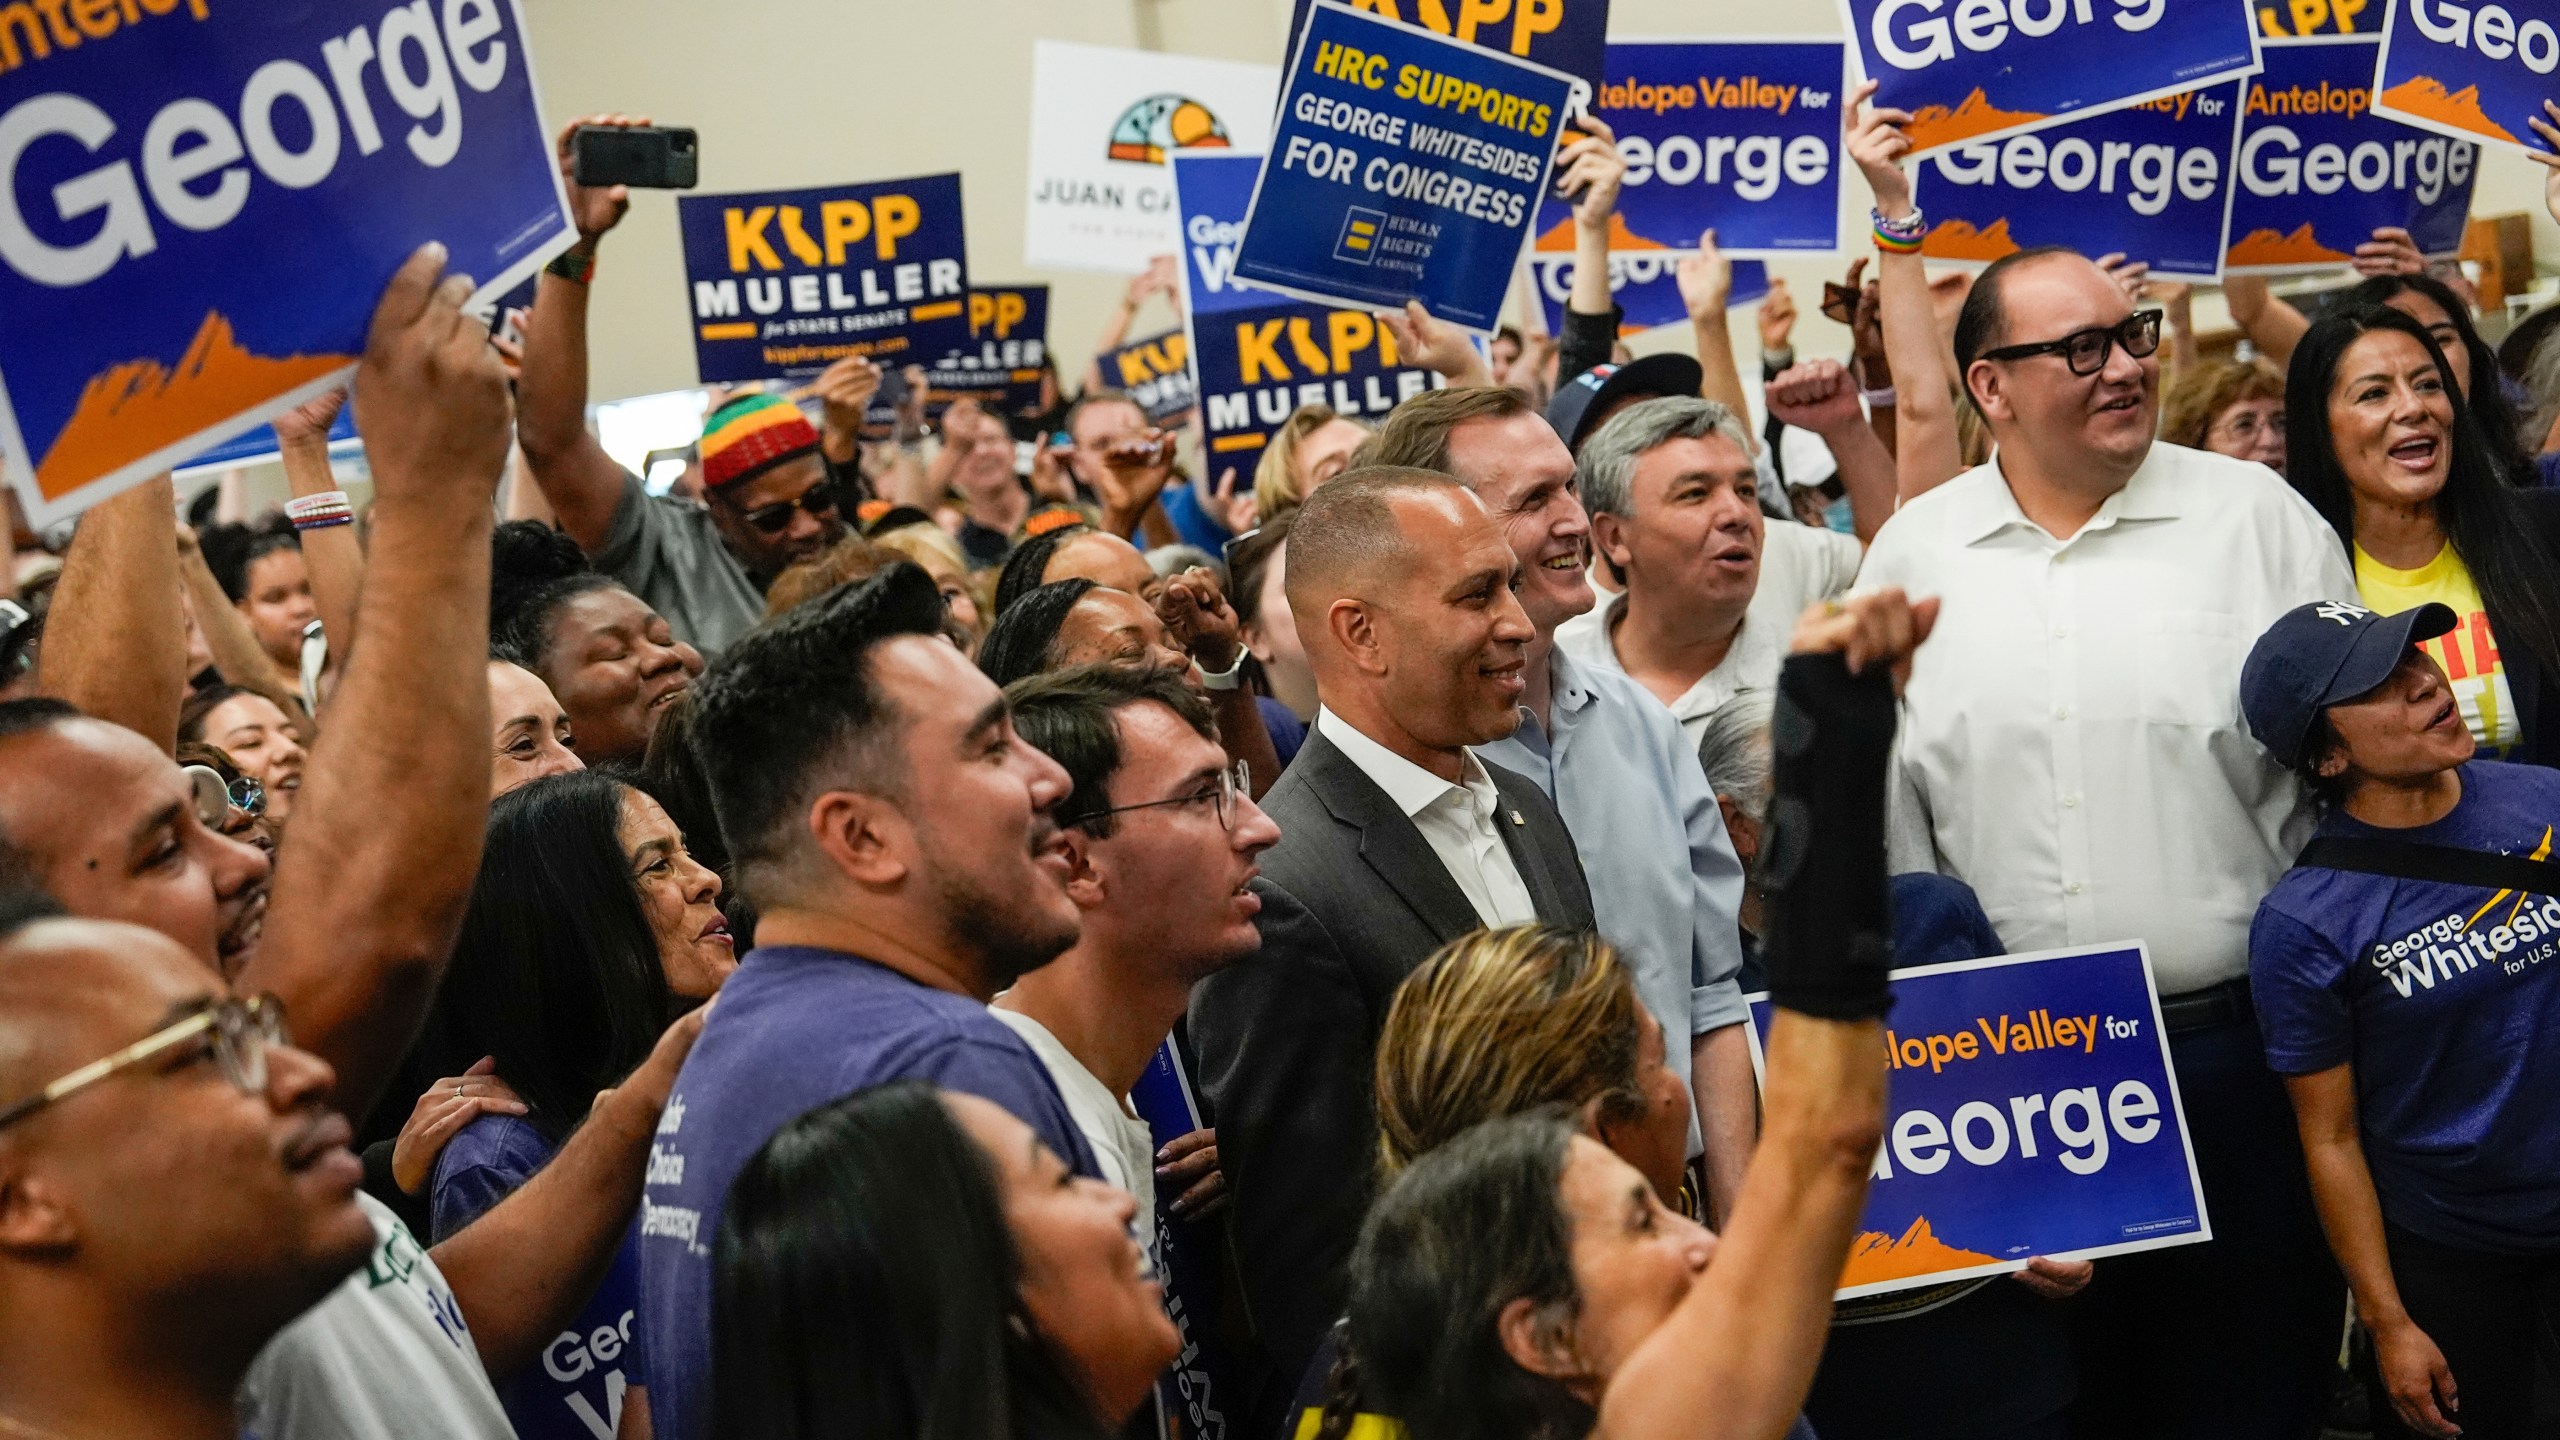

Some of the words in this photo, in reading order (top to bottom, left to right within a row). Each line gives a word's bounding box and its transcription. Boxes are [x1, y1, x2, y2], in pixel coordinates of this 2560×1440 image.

[1313, 40, 1389, 90] HRC
[1393, 64, 1551, 137] SUPPORTS
[1698, 75, 1797, 116] Valley
[1799, 86, 1831, 109] for
[2196, 93, 2225, 117] for
[0, 0, 507, 287] George
[1294, 92, 1406, 146] GEORGE
[1408, 122, 1541, 183] WHITESIDES
[1035, 178, 1126, 208] JUAN
[1282, 135, 1358, 185] FOR
[1364, 156, 1527, 228] CONGRESS
[1613, 135, 1830, 201] eorge
[2239, 125, 2473, 206] George
[1381, 236, 1433, 258] RIGHTS
[1388, 215, 1441, 238] HUMAN
[693, 258, 962, 318] MUELLER
[785, 316, 841, 336] STATE
[841, 308, 908, 332] SENATE
[2372, 914, 2465, 969] George
[2503, 957, 2526, 977] for
[2527, 942, 2557, 965] U.S.
[1977, 1008, 2098, 1055] Valley
[2104, 1014, 2140, 1040] for
[1867, 1079, 2162, 1180] eorge
